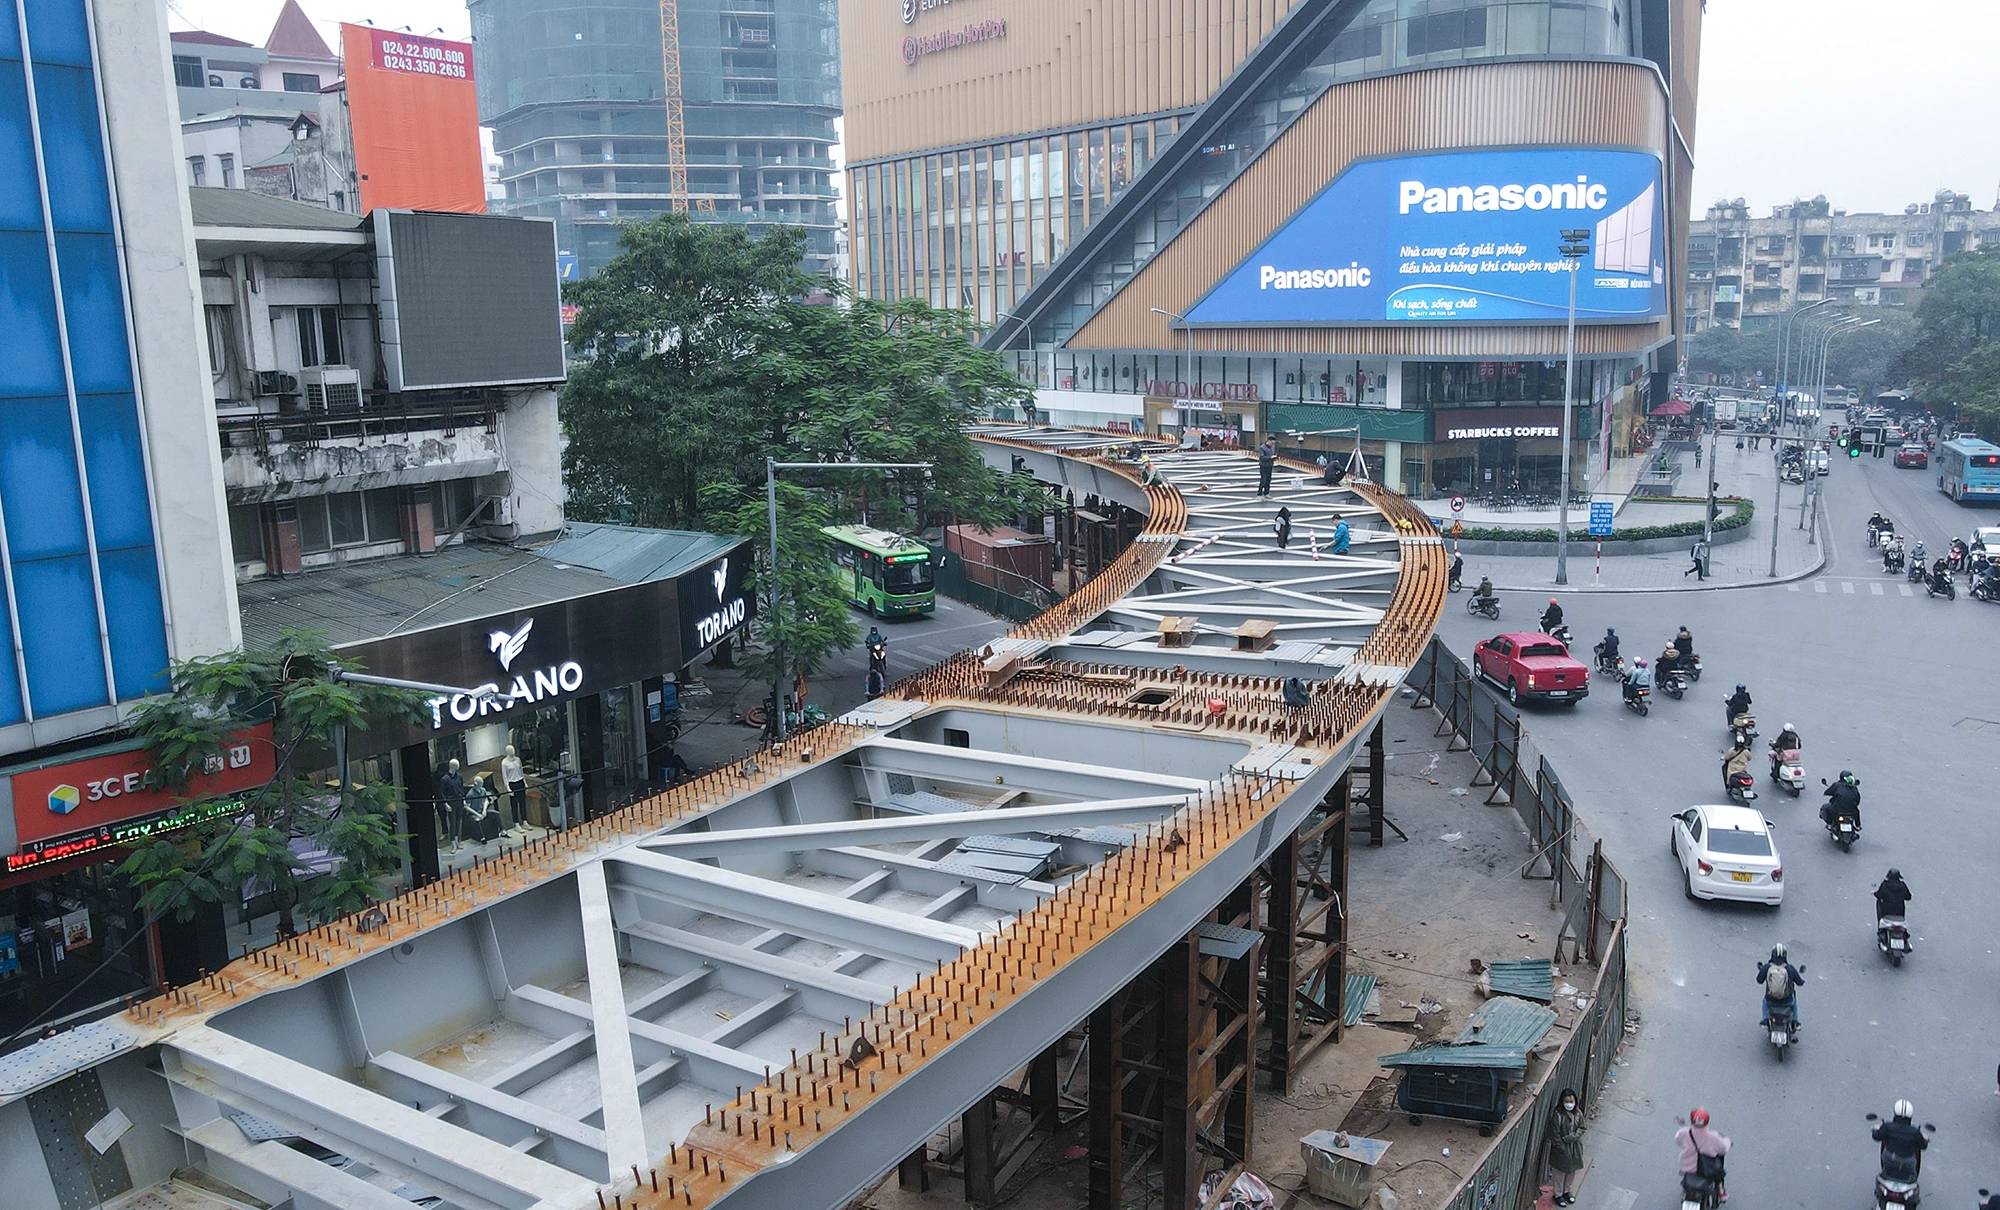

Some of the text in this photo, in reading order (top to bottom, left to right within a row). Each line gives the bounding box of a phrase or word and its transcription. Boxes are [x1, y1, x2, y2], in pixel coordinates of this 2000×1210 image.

[963, 24, 984, 43] Hot
[984, 19, 1006, 38] Pot
[382, 40, 465, 64] 024.22.600.600
[384, 55, 466, 78] 0243.350.2636
[1400, 175, 1608, 214] Panasonic
[1400, 242, 1527, 258] Nhà cung cấp giải pháp
[1260, 262, 1371, 290] Panasonic
[1400, 260, 1420, 274] điều
[1421, 261, 1442, 273] hòa
[1443, 261, 1478, 274] không
[1480, 260, 1499, 272] khí
[1501, 260, 1542, 274] chuyên
[1393, 299, 1407, 309] Khí
[1431, 297, 1454, 310] sống
[1455, 297, 1478, 309] chất
[1502, 368, 1517, 376] QLO
[1144, 380, 1261, 400] VINCOM CENTER
[1448, 427, 1559, 439] STARBUCKS COFFEE
[696, 598, 745, 648] TORANO
[428, 661, 583, 729] TORANO
